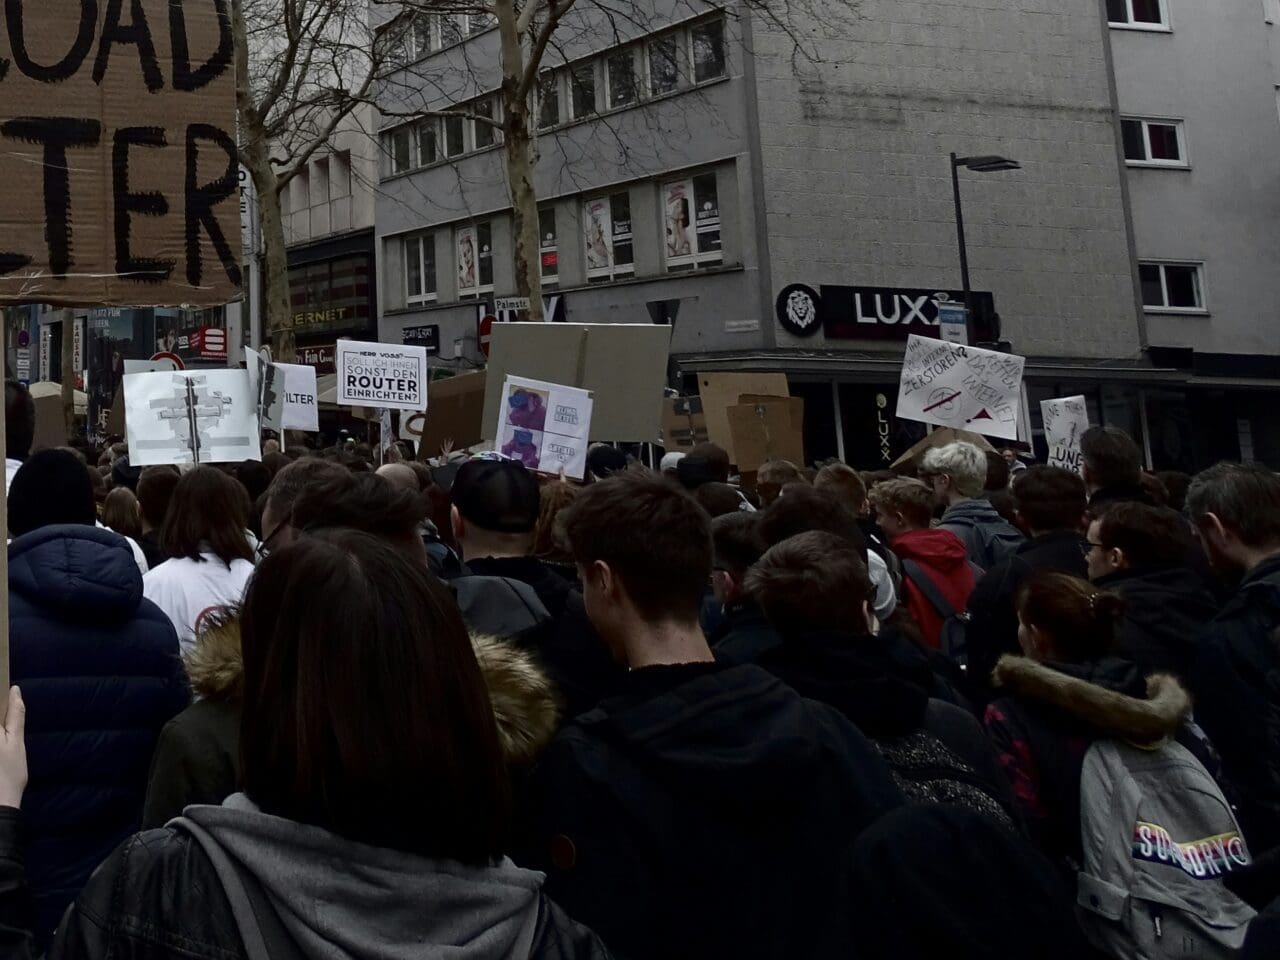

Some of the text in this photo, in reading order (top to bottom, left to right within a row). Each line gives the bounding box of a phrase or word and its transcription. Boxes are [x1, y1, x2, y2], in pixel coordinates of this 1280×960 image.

[293, 307, 347, 325] ERNET
[347, 357, 417, 370] SOLL ICH IHNEN
[347, 365, 417, 380] SONST DEN
[347, 375, 418, 393] ROUTER
[347, 388, 418, 402] EINRICHTEN?
[877, 410, 892, 461] LUXX
